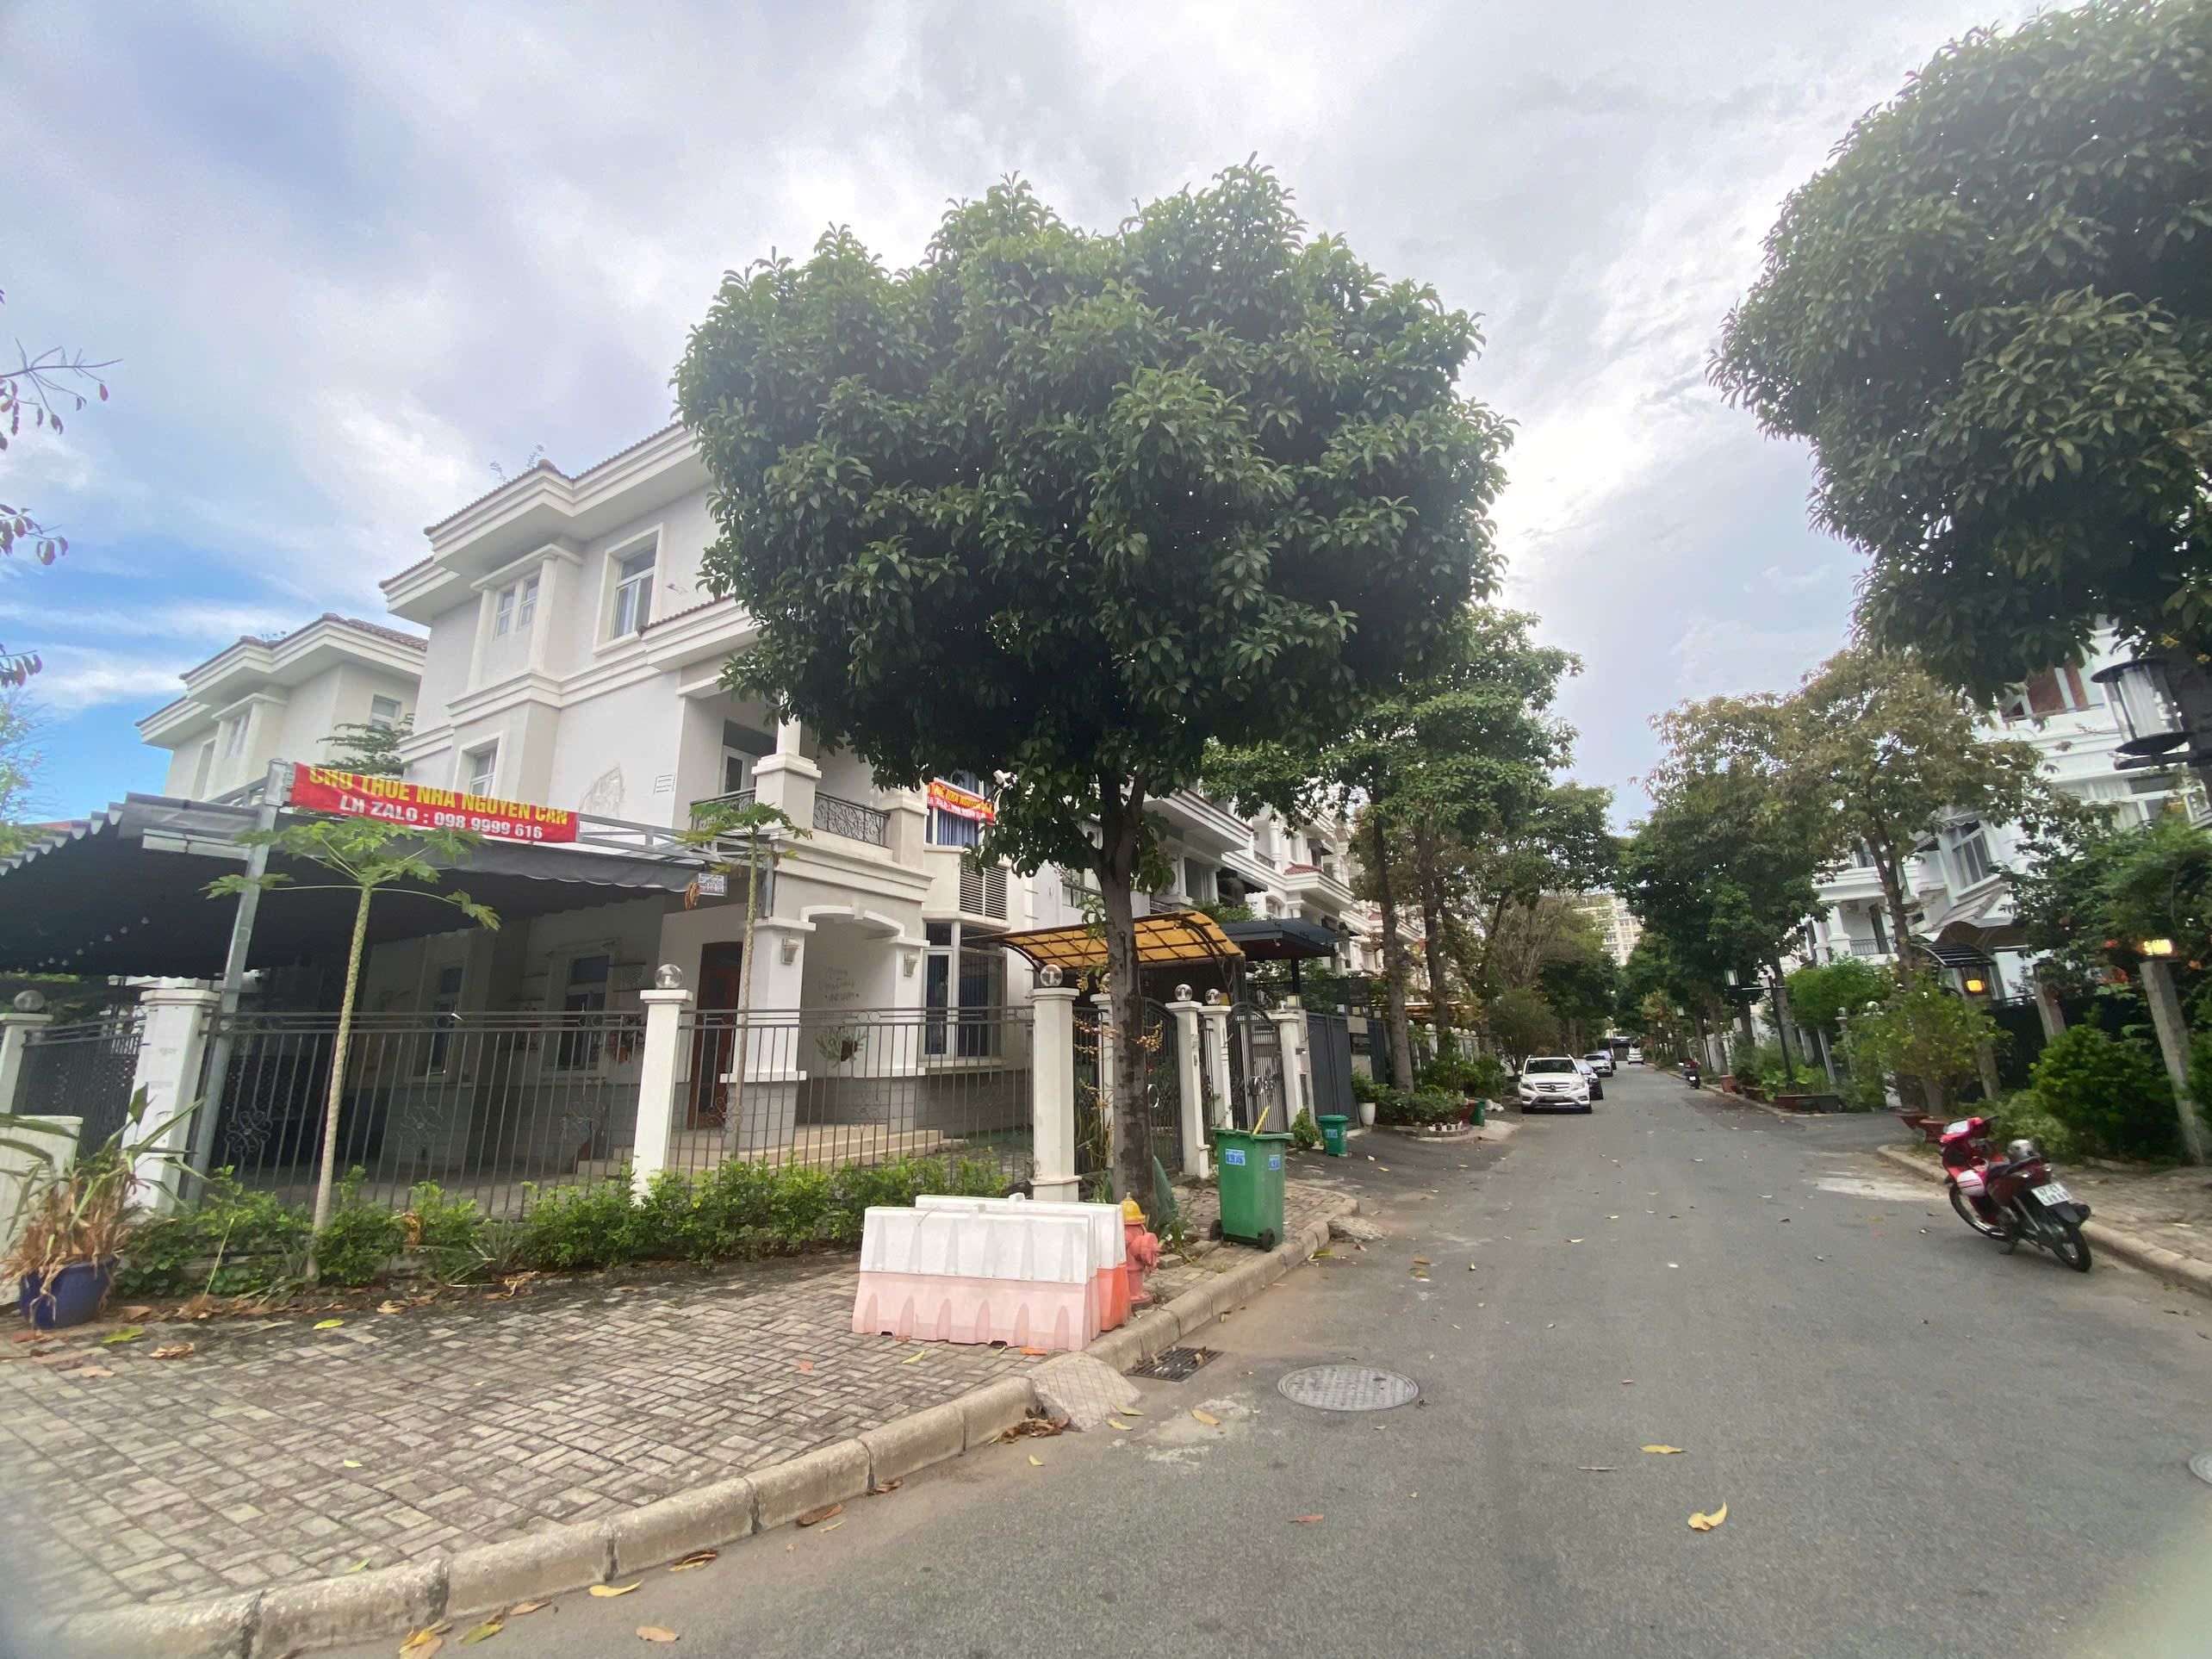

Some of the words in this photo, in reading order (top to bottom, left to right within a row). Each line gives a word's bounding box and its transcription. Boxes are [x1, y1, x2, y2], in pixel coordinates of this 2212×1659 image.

[339, 795, 365, 813] LH
[370, 801, 419, 822] ZALO
[433, 811, 466, 830] 098
[471, 817, 511, 835] 9999
[514, 823, 544, 840] 616
